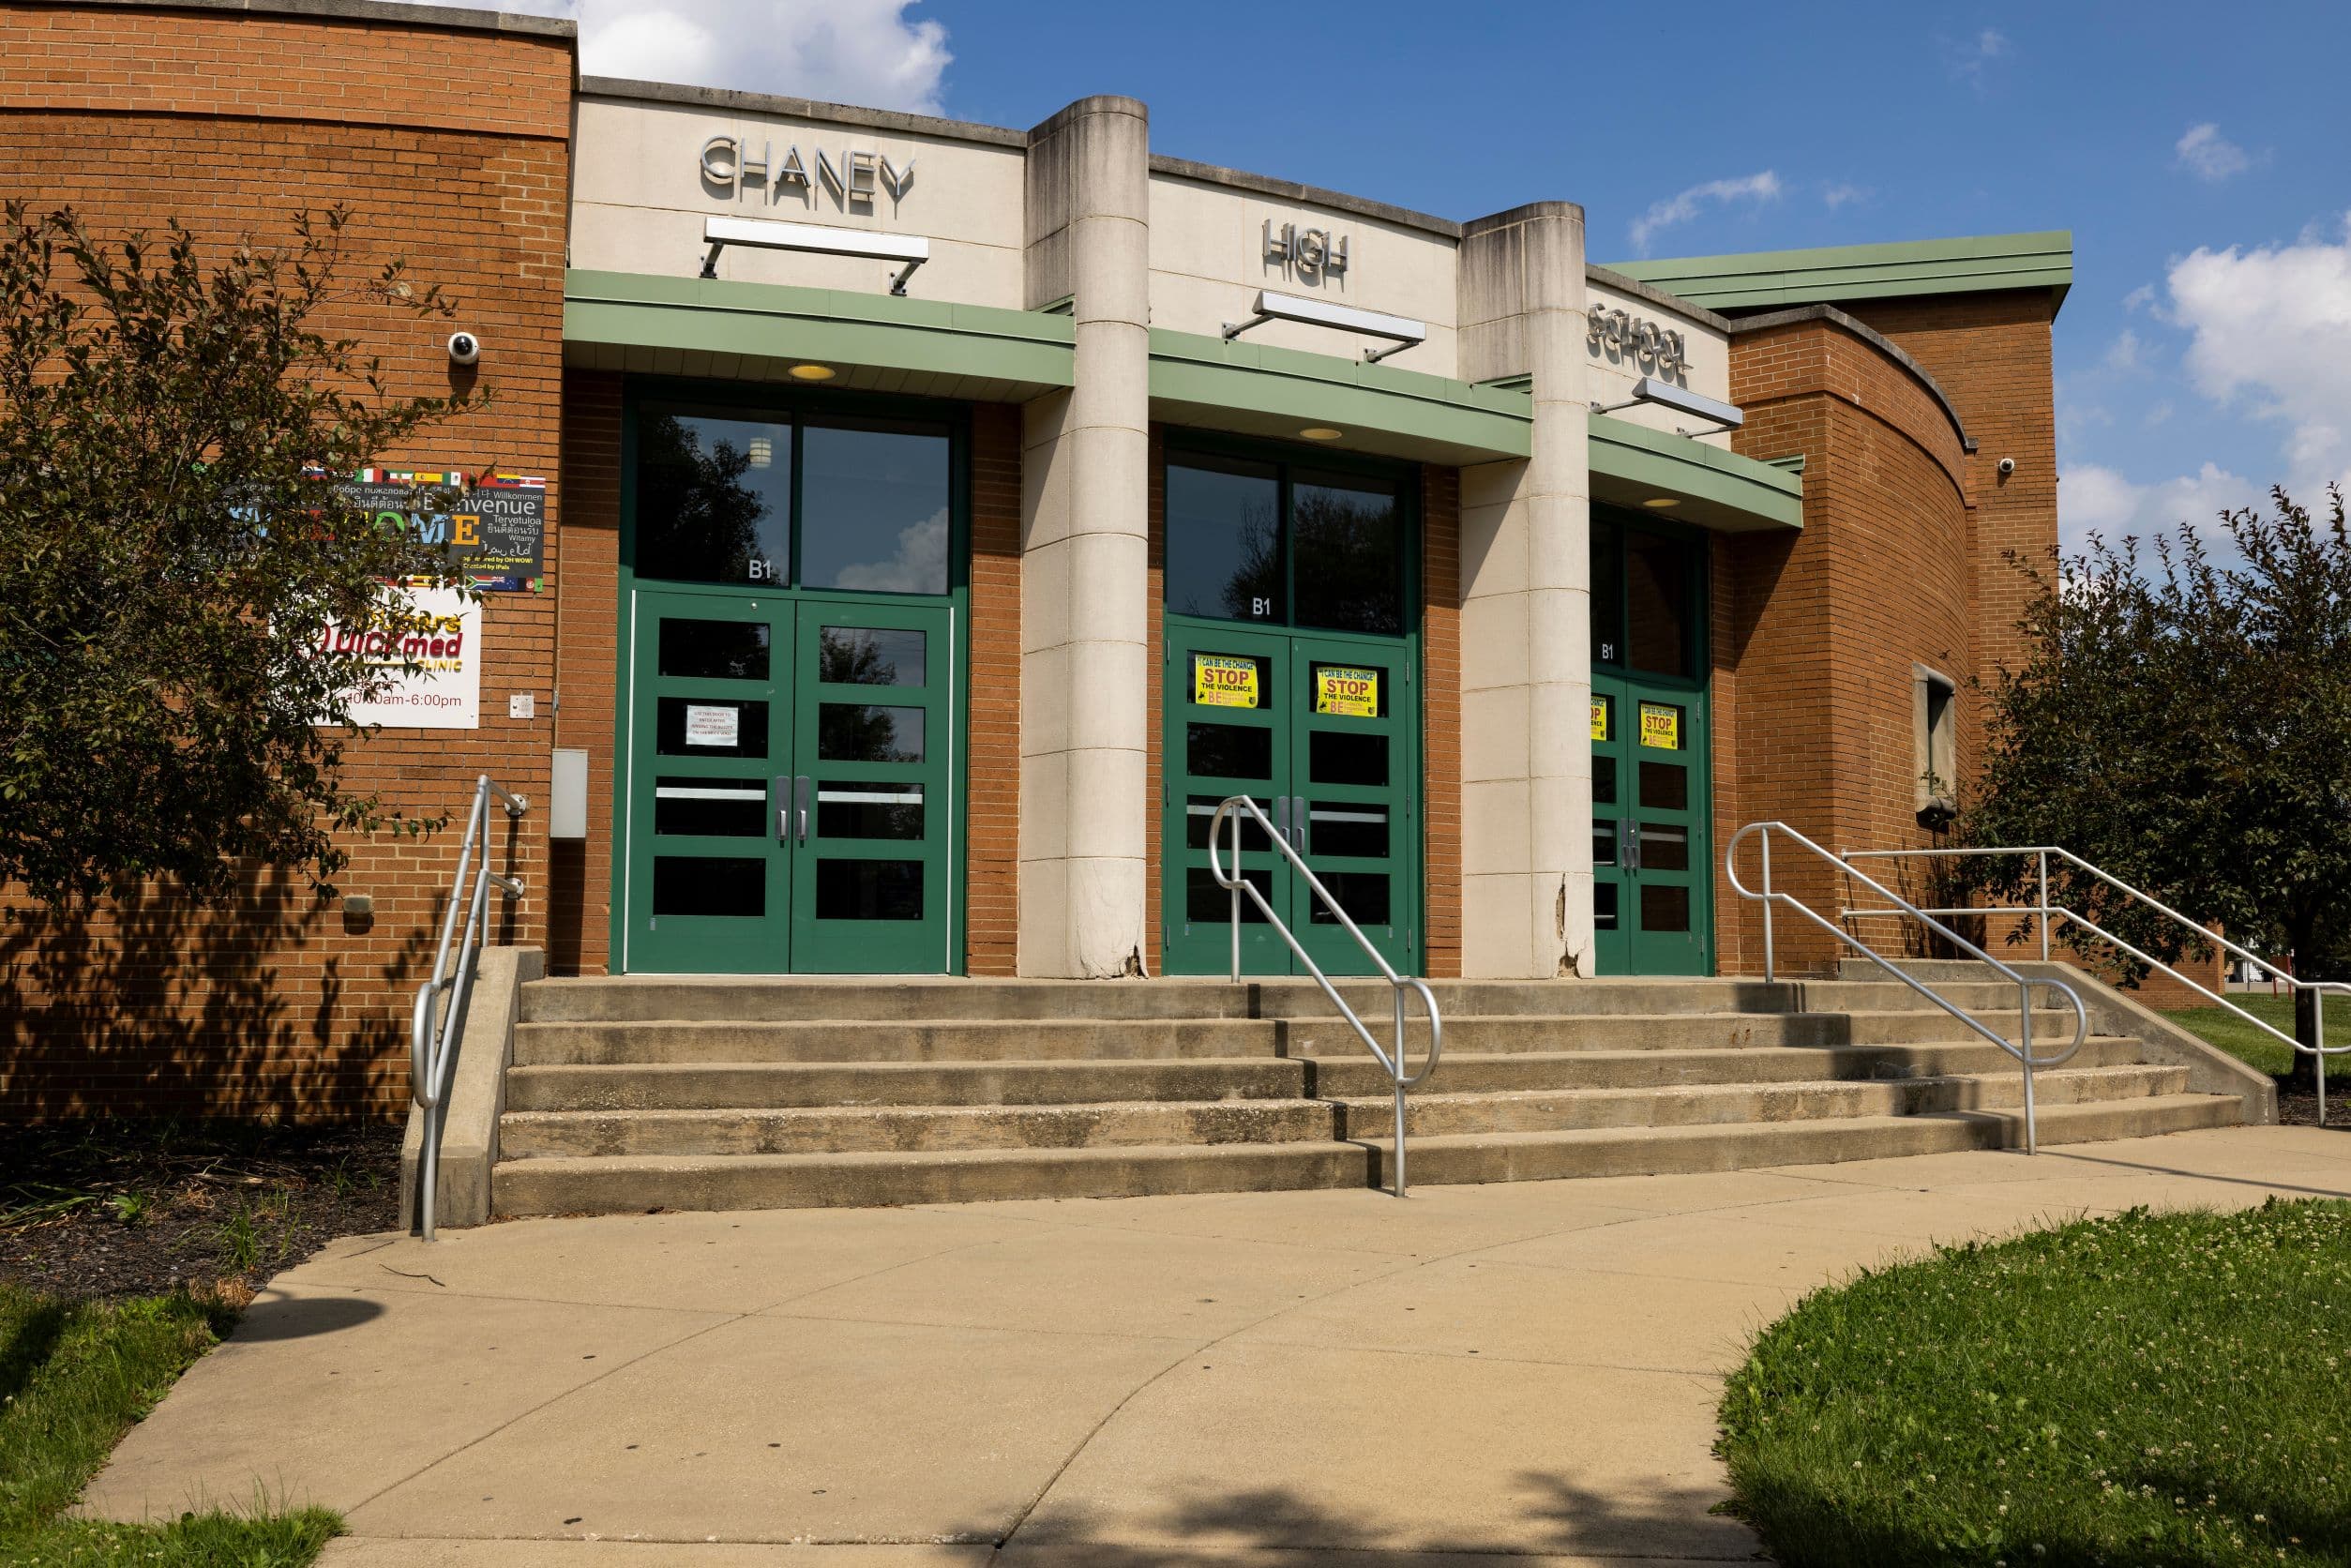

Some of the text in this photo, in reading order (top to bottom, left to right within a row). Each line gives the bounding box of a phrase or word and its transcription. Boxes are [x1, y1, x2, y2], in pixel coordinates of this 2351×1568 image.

[701, 134, 916, 196] CHANEY
[1262, 219, 1349, 272] HIGH
[1587, 303, 1695, 370] SCHOOL
[424, 492, 535, 515] Bnvenue
[493, 490, 543, 502] Willkommen
[493, 515, 542, 525] Tervetuloa
[508, 534, 536, 544] Witamy
[748, 559, 772, 579] B1
[1253, 596, 1271, 615] B1
[1602, 643, 1613, 659] B1
[1214, 659, 1221, 668] BE
[1222, 660, 1232, 669] THE
[1204, 668, 1249, 686] STOP
[1336, 670, 1343, 678] BE
[1344, 671, 1353, 679] THE
[1217, 684, 1253, 692] VIOLENCE
[1326, 679, 1369, 696] STOP
[1209, 690, 1222, 704] BE
[1339, 694, 1372, 703] VIOLENCE
[1330, 701, 1344, 714] BE
[1646, 716, 1672, 731] STOP
